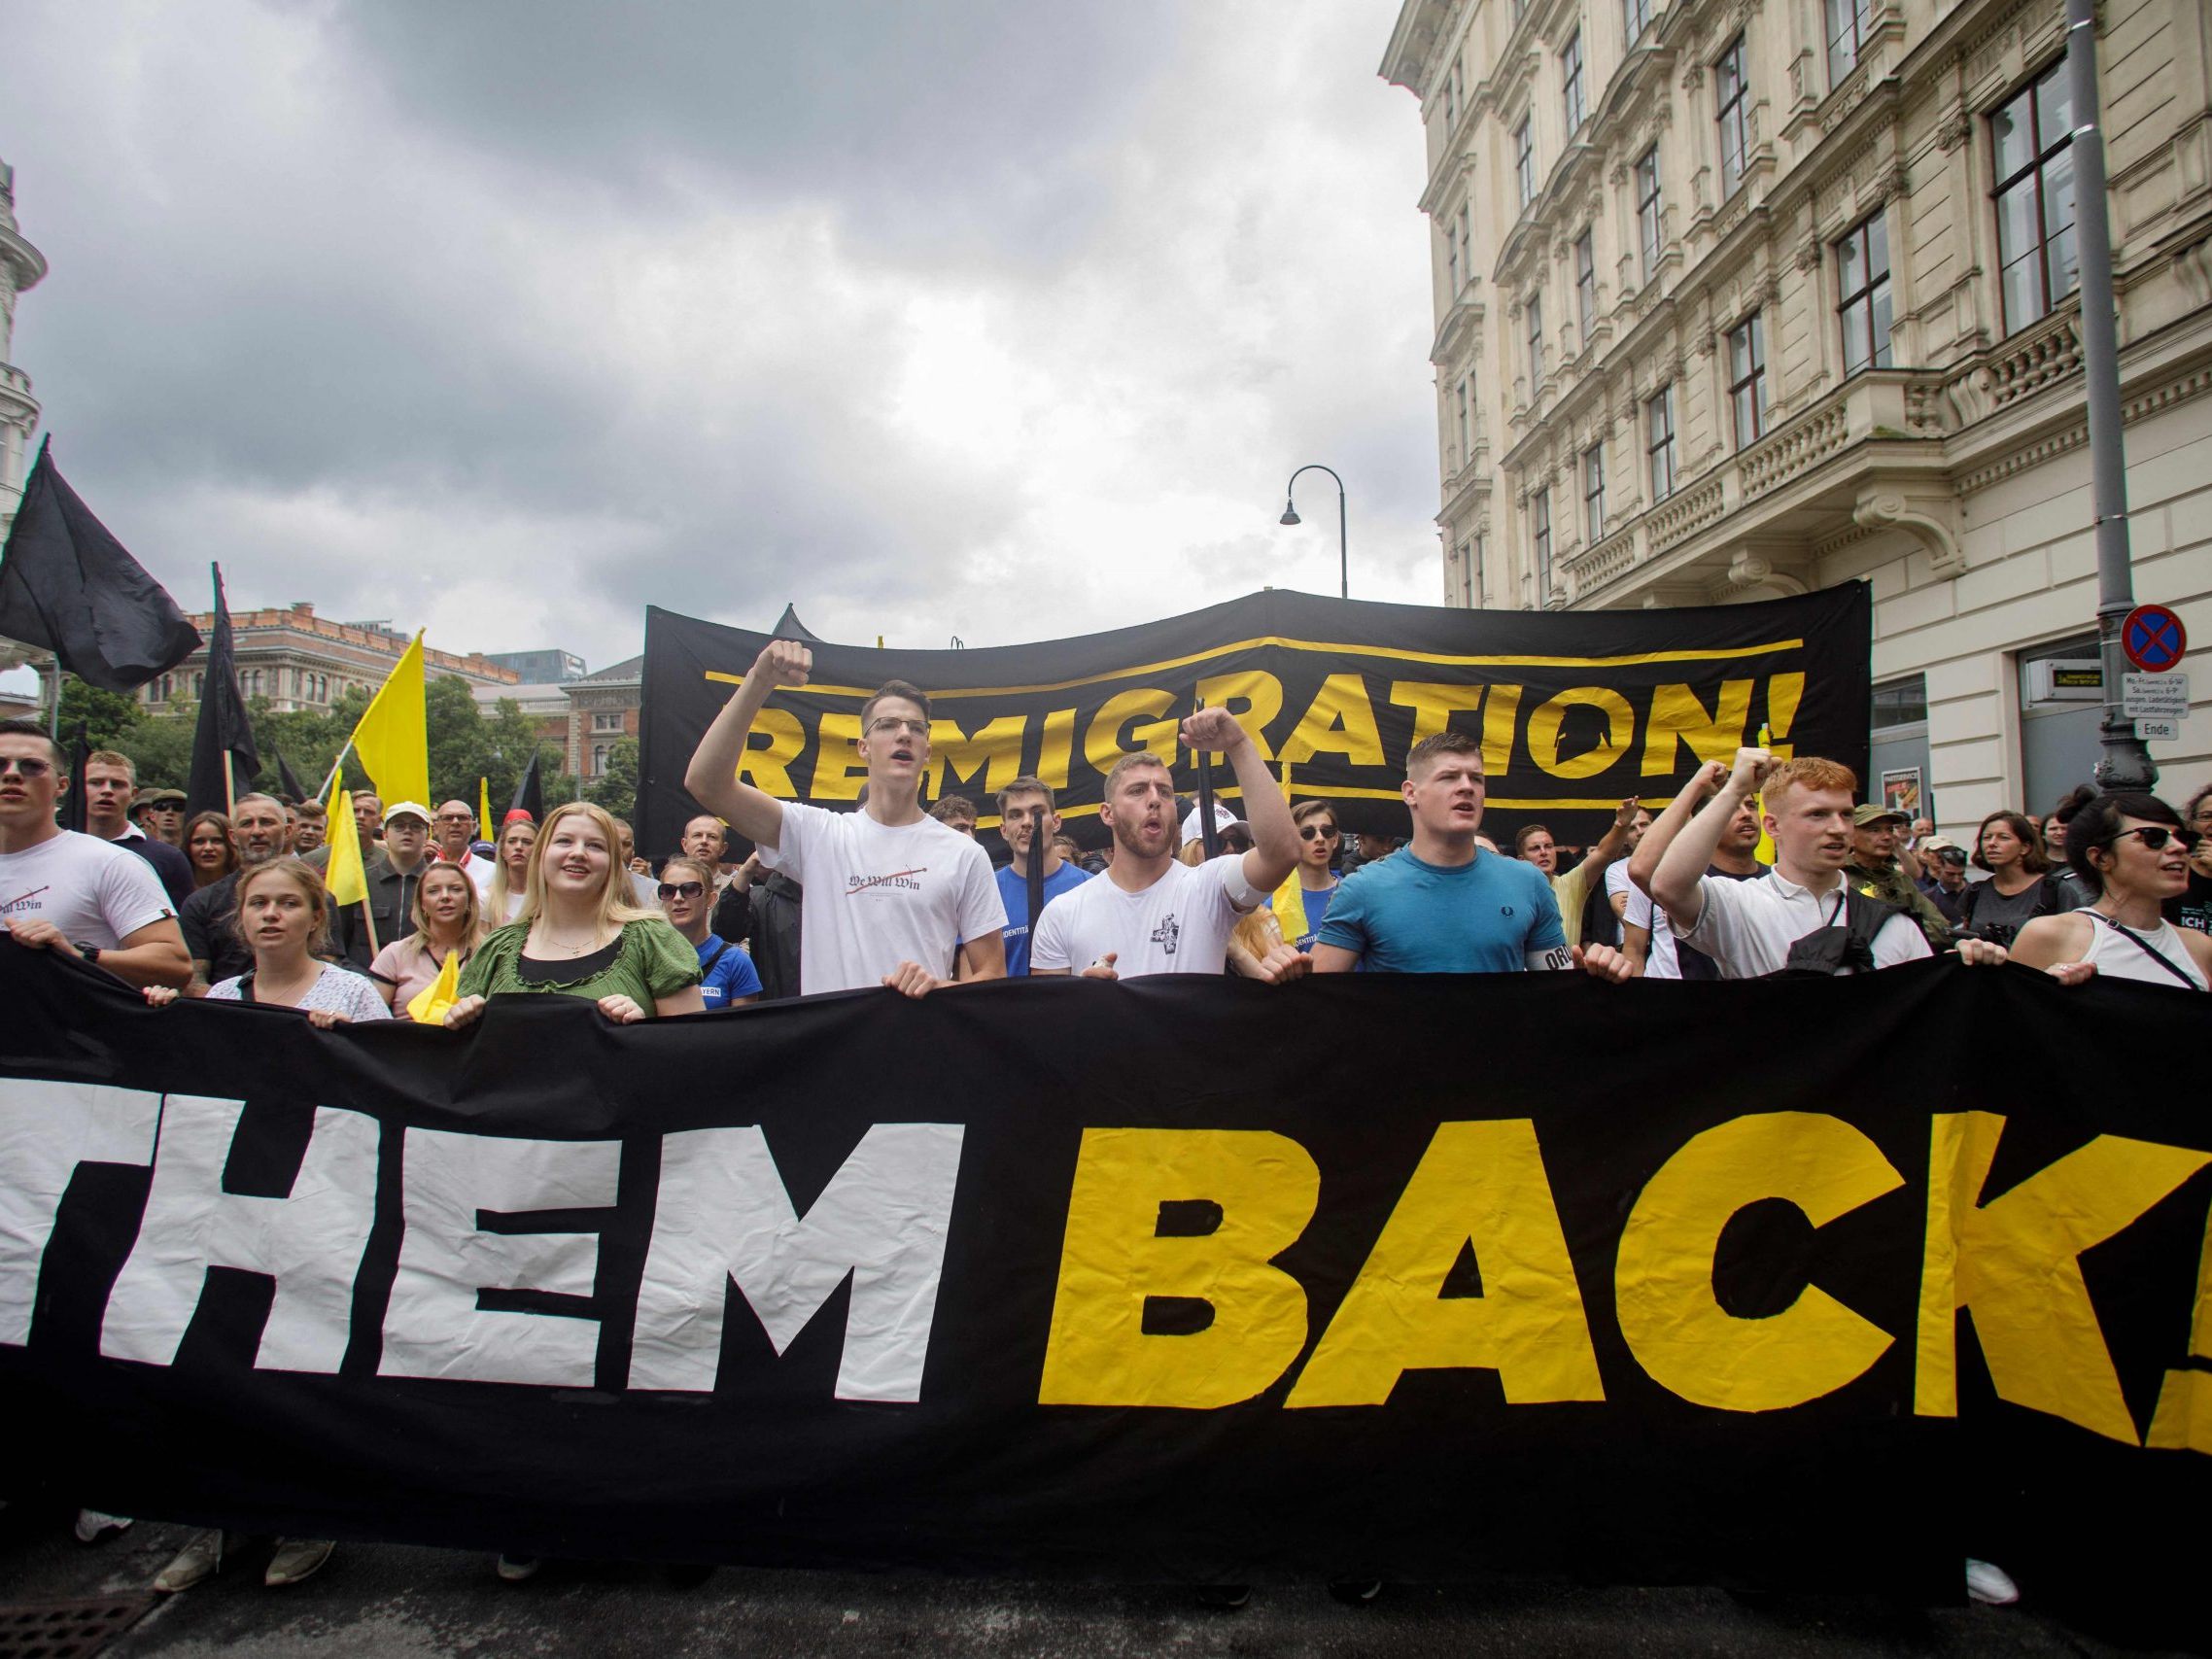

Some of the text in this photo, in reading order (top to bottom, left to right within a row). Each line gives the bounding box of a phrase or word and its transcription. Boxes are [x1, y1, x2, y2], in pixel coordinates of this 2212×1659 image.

[724, 670, 1805, 801] REMIGRATION!
[2144, 723, 2169, 735] Ende
[848, 876, 920, 890] We Will Win
[16, 900, 42, 911] Win
[2181, 916, 2205, 929] ICH
[0, 1078, 966, 1403] THEM
